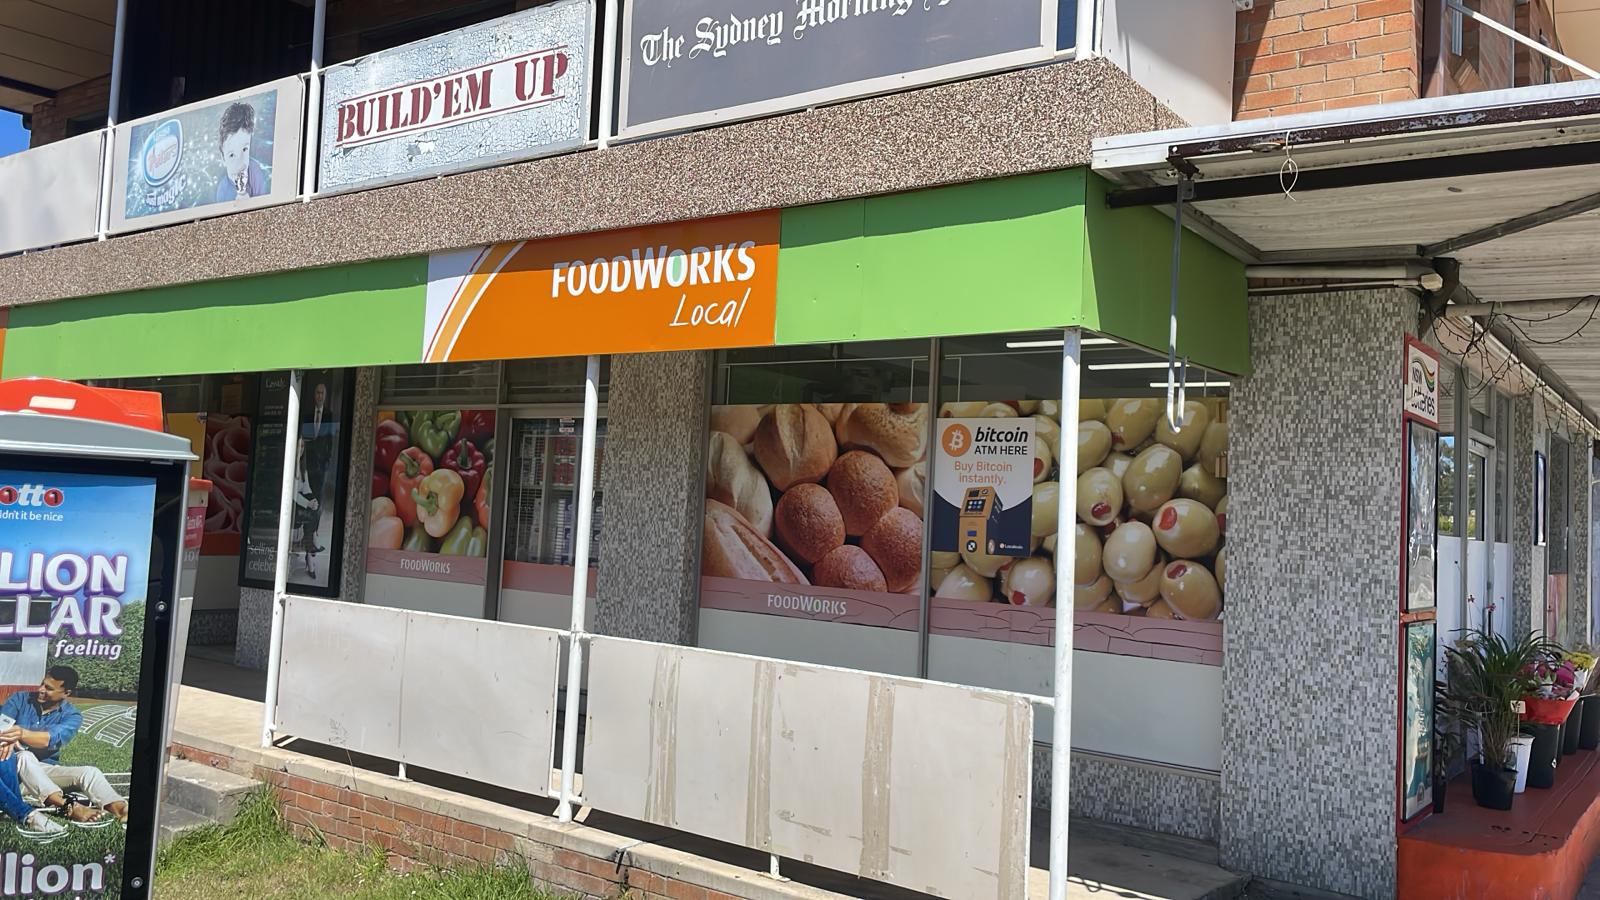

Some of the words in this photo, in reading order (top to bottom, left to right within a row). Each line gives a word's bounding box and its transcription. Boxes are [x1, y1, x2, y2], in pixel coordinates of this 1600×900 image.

[640, 26, 685, 67] The
[688, 10, 784, 59] Sydney
[336, 69, 494, 142] BUILD'EM
[514, 52, 569, 101] UP
[551, 240, 756, 298] FOODWORKS
[669, 287, 751, 328] Local
[974, 427, 1029, 443] bitcoin
[974, 445, 997, 455] ATM
[1000, 445, 1028, 456] HERE
[954, 461, 974, 475] Buy
[976, 461, 1013, 472] Bitcoin
[959, 473, 1007, 485] instantly.
[21, 511, 28, 520] it
[29, 511, 42, 521] be
[43, 511, 64, 522] nice
[400, 558, 451, 574] FOODWORKS
[767, 594, 847, 615] FOODWORKS
[54, 639, 122, 660] feeling
